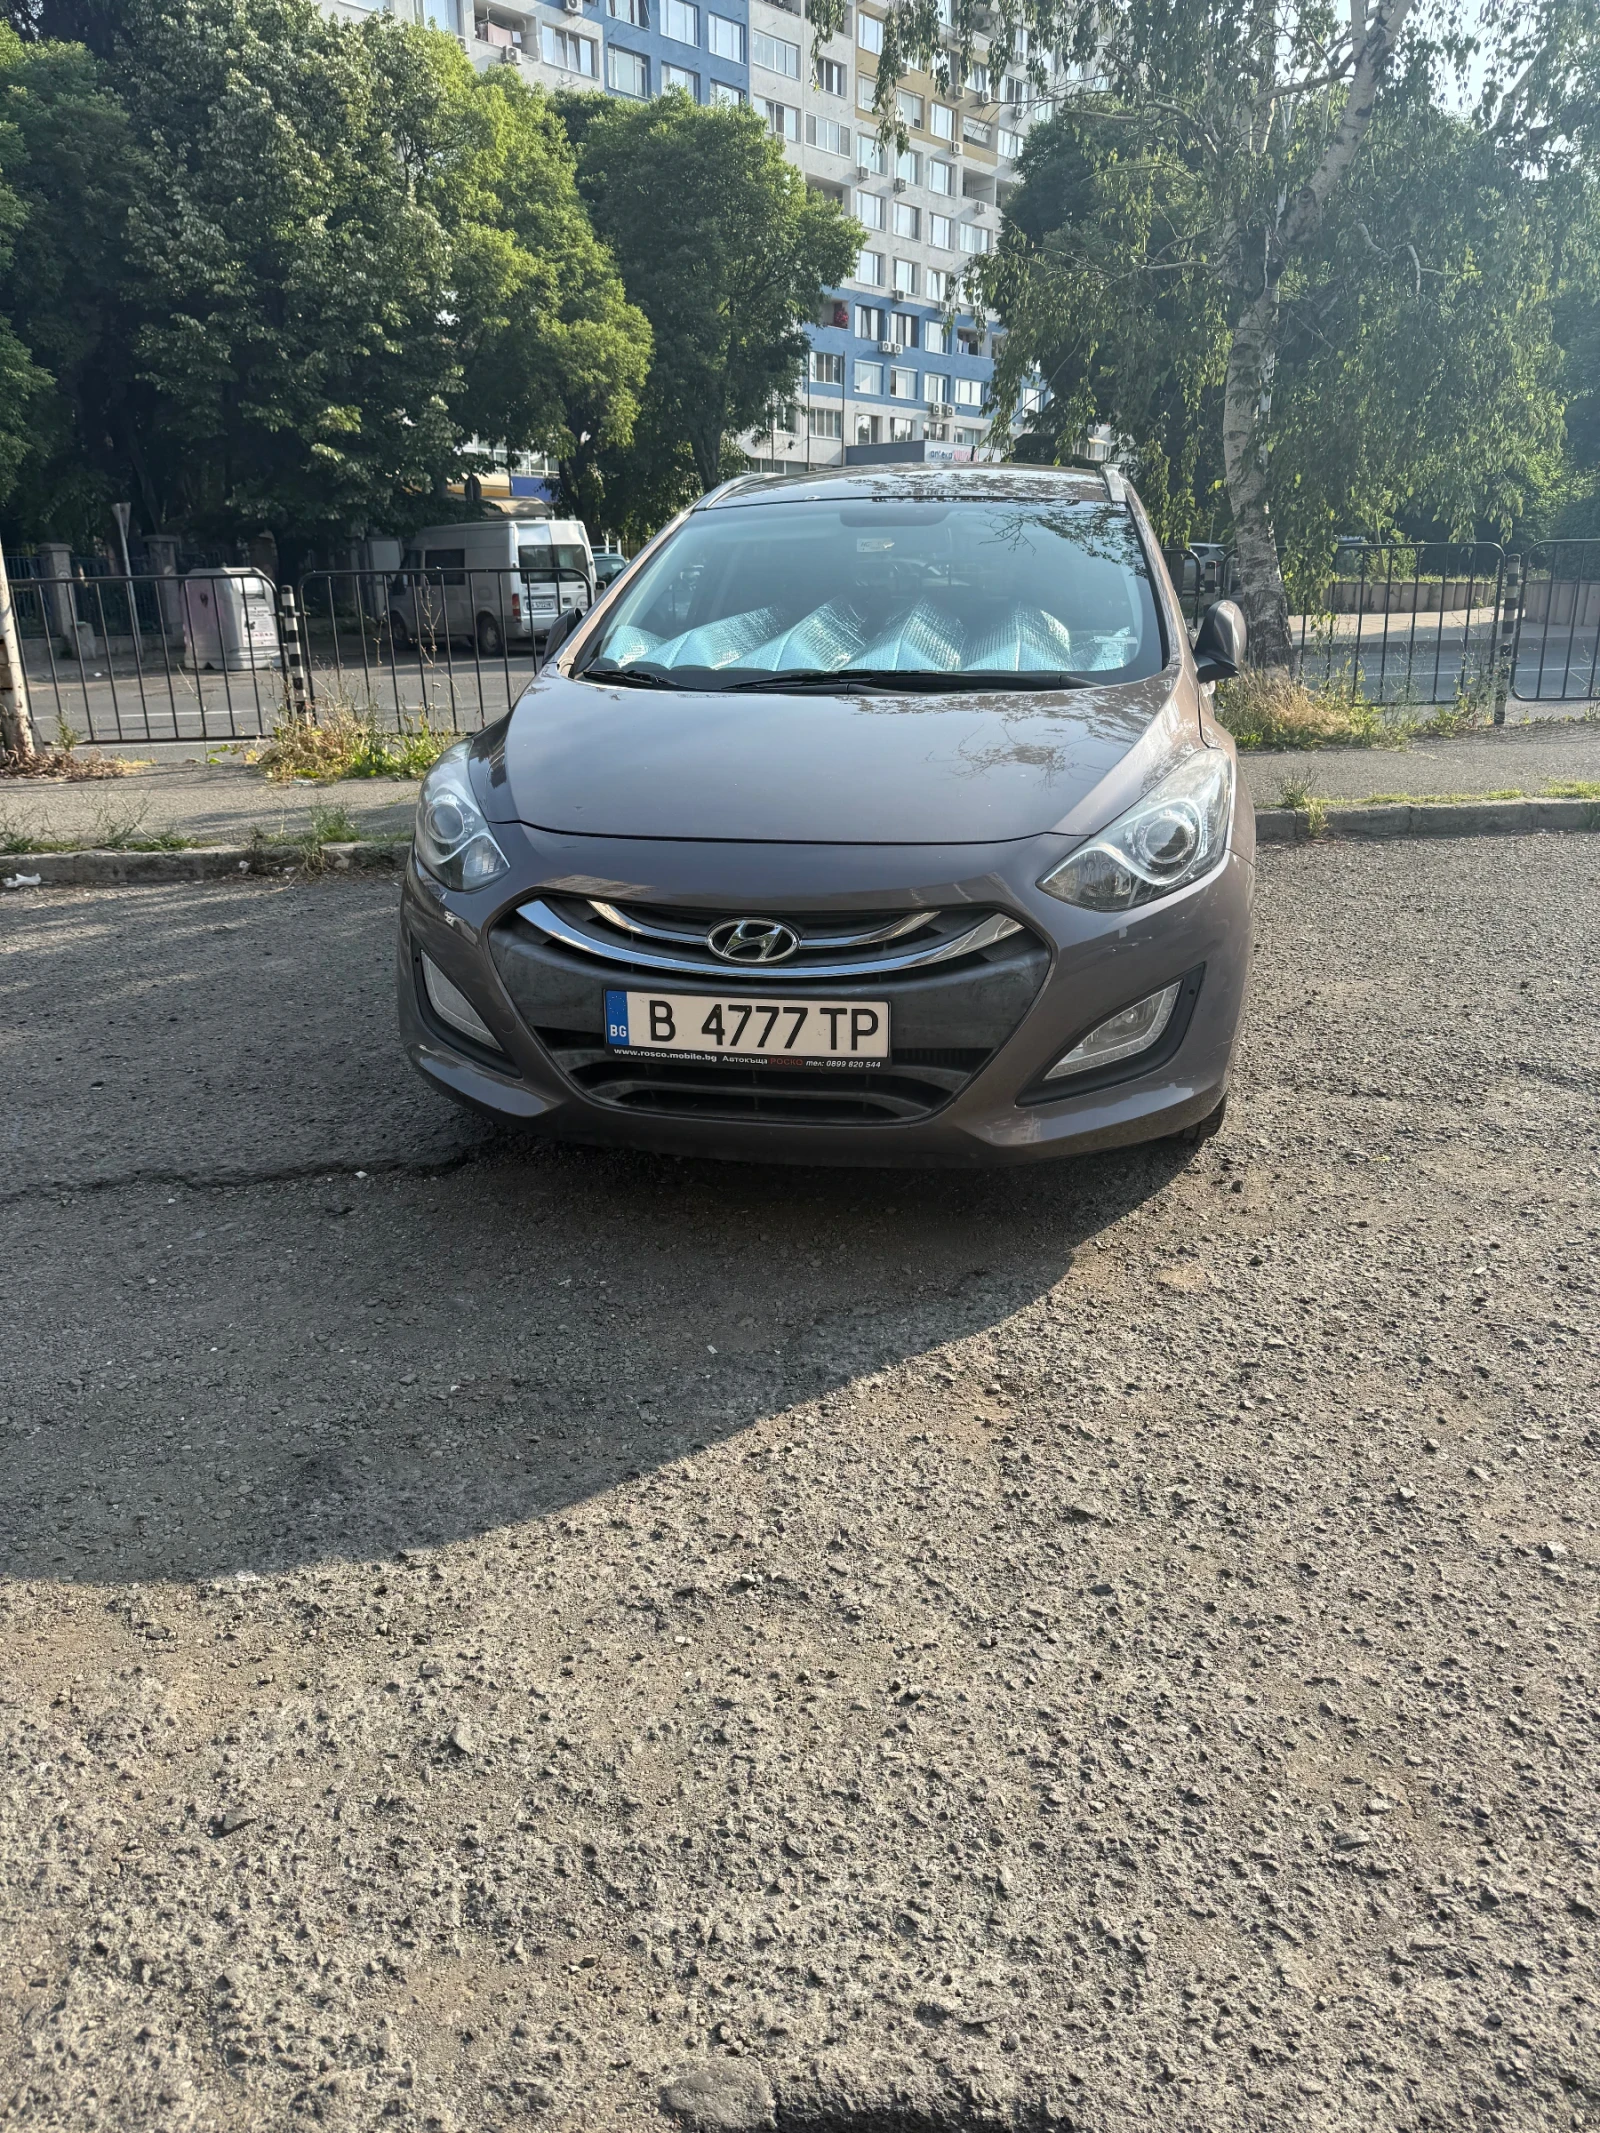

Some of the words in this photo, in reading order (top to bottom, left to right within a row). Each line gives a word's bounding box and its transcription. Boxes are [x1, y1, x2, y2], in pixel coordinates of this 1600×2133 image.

[610, 1025, 628, 1038] BG
[701, 1003, 809, 1049] 4777
[819, 1007, 879, 1051] TP
[613, 1048, 718, 1063] www.rosco.mobile.bg
[722, 1055, 768, 1065] Автокъща
[770, 1057, 804, 1067] РОСКО
[805, 1060, 825, 1068] тел:
[825, 1060, 847, 1068] 0899
[848, 1061, 864, 1069] 820
